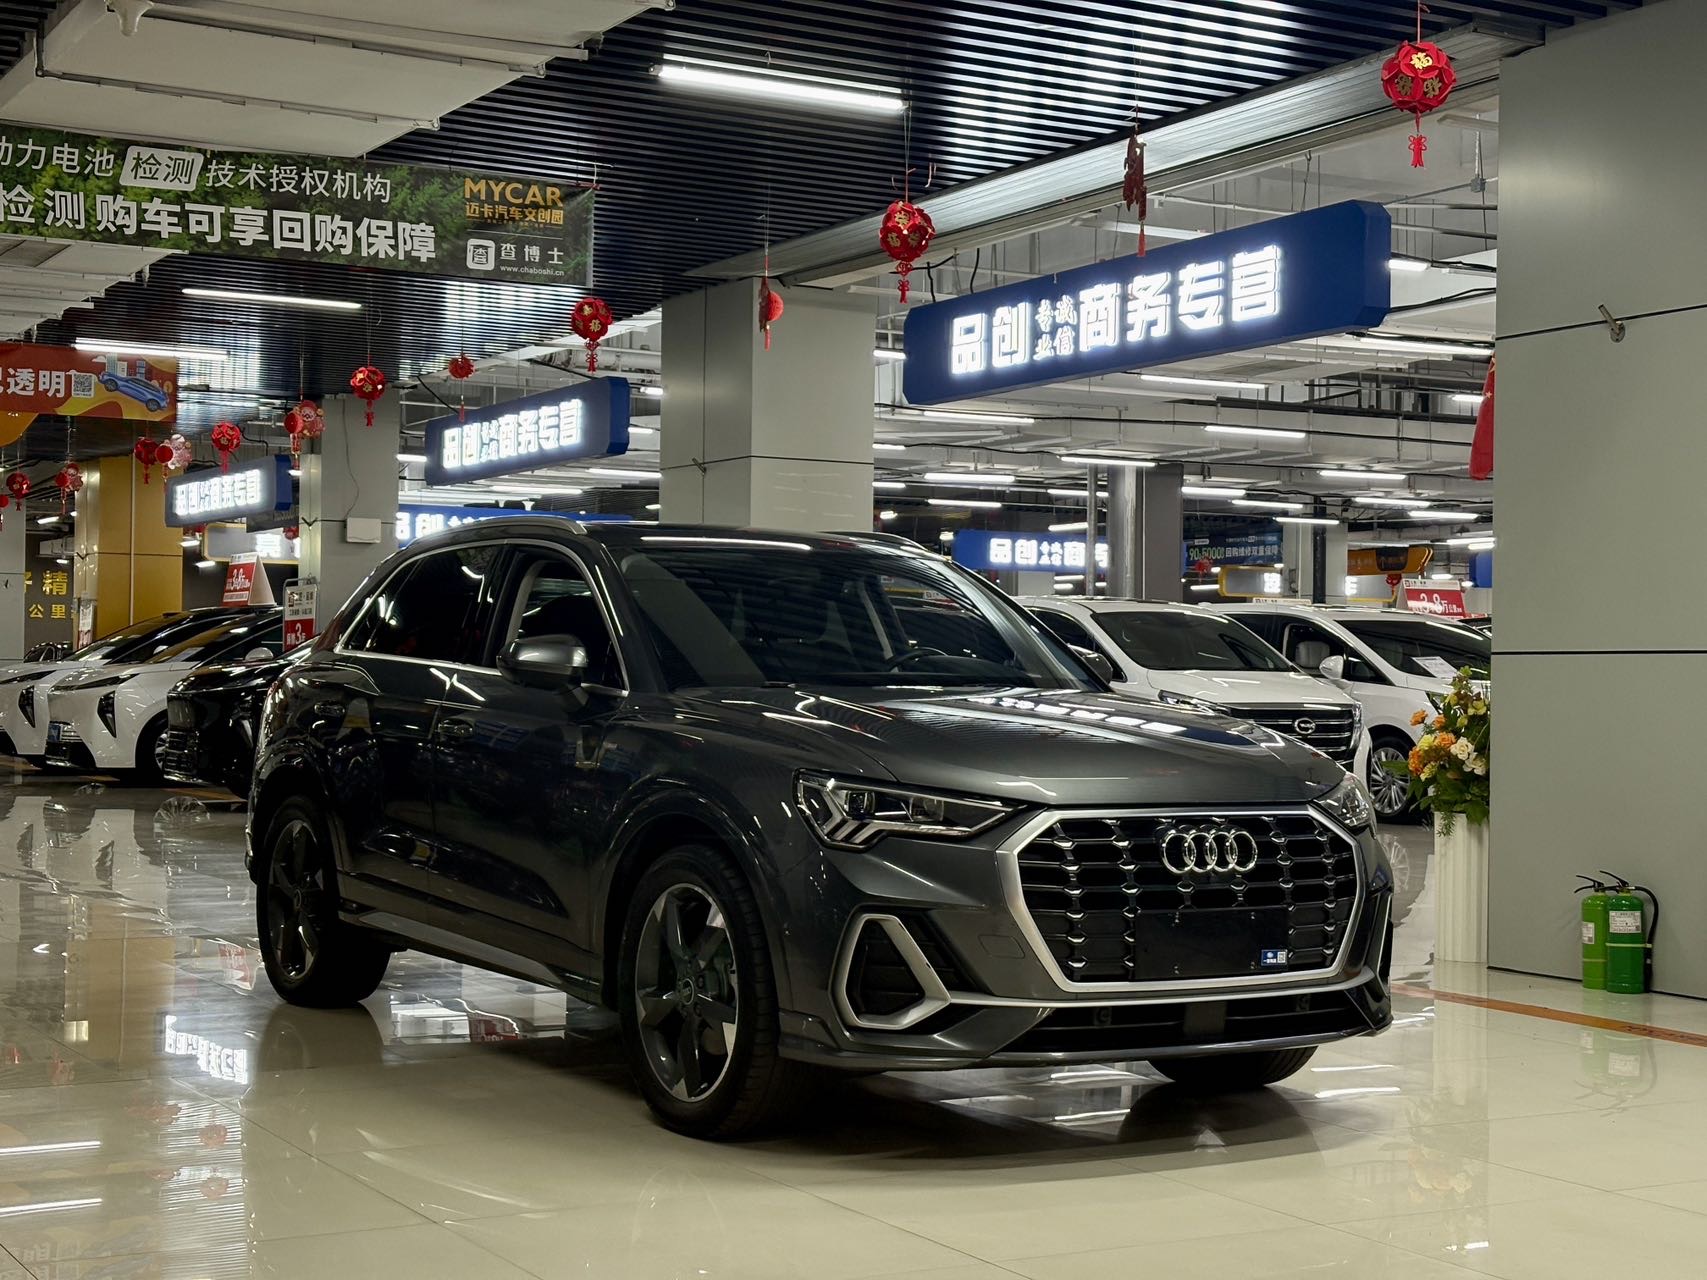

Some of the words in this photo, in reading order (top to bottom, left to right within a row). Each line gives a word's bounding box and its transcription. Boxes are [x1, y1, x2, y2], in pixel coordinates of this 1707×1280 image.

[130, 151, 195, 185] 检测
[205, 159, 391, 204] 技术授权机构
[464, 177, 564, 207] MYCAR
[465, 202, 564, 225] 迈卡汽车文创园
[500, 243, 564, 265] 查博士
[500, 265, 565, 277] www.chaboshi.cn
[951, 301, 1031, 375] 品创
[1080, 244, 1282, 352] 商务专营
[0, 366, 66, 398] 透明
